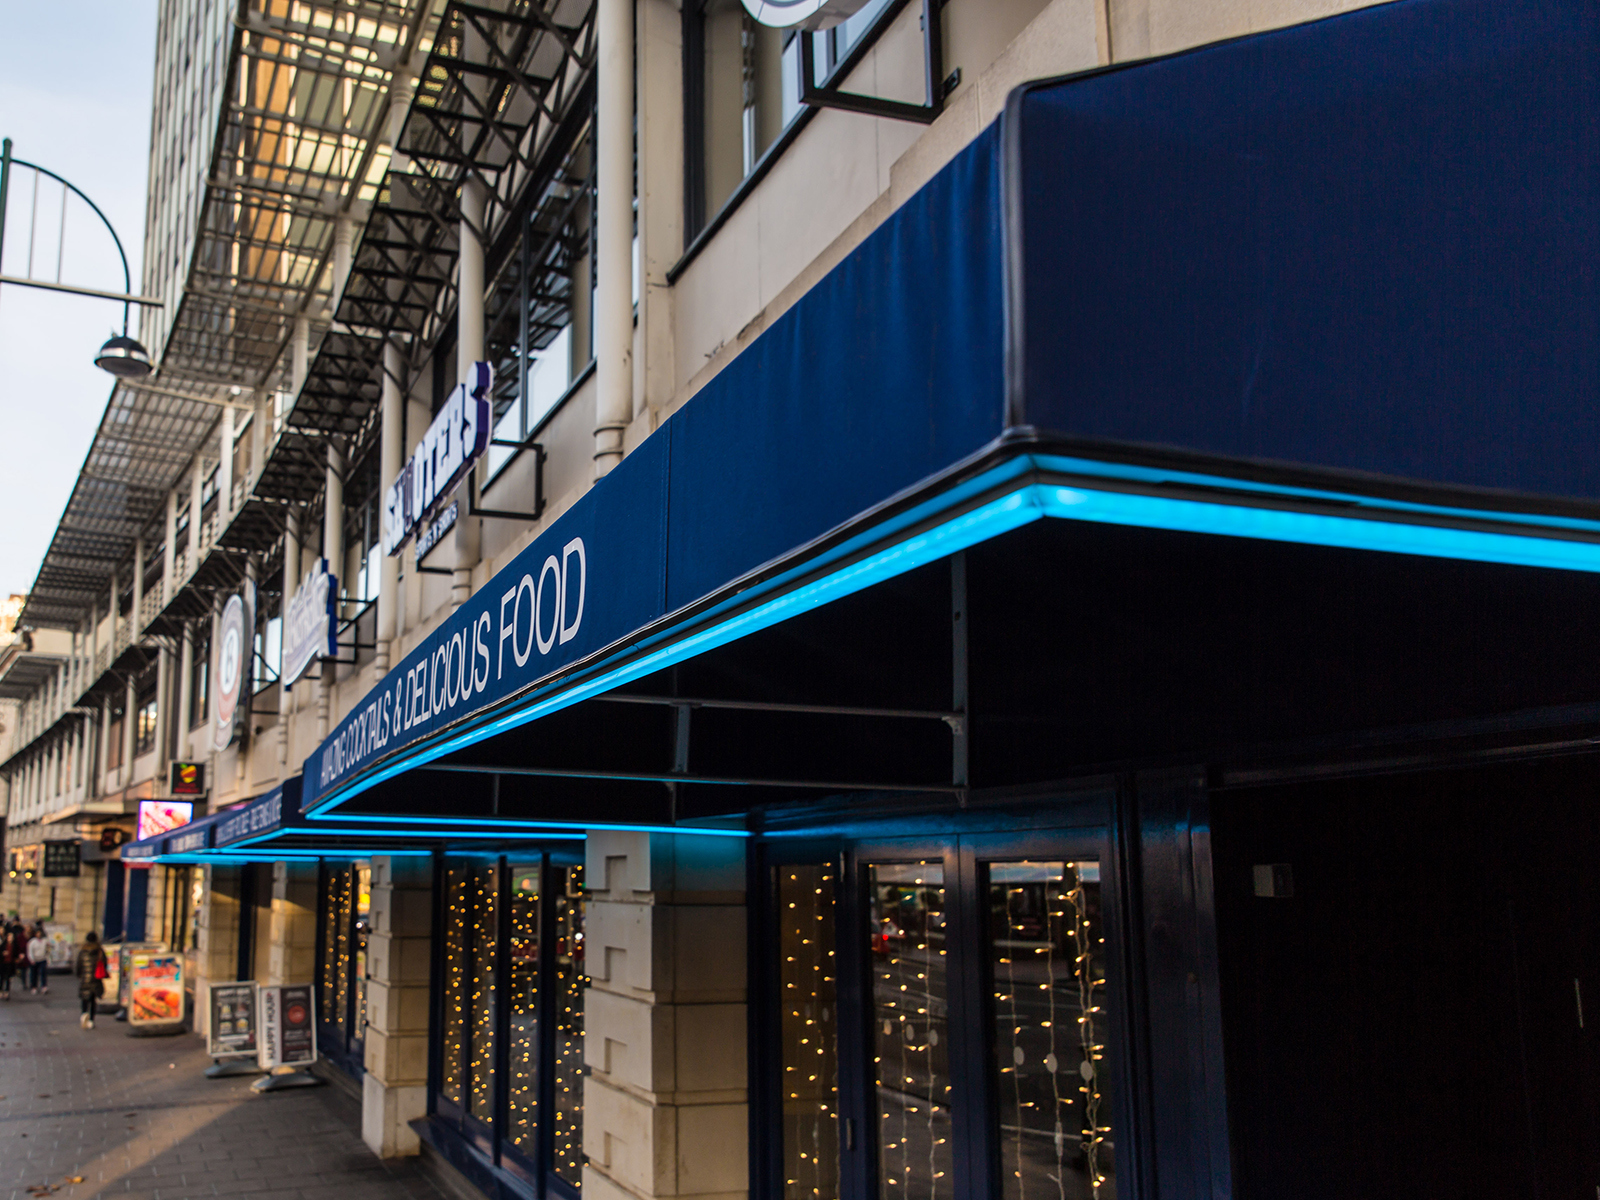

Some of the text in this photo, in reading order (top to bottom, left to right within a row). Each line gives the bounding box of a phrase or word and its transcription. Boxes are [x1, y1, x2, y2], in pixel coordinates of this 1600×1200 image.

[346, 689, 391, 770] COCKTAILS
[393, 677, 402, 737] &
[404, 611, 491, 731] DELICIOUS
[497, 536, 586, 680] FOOD
